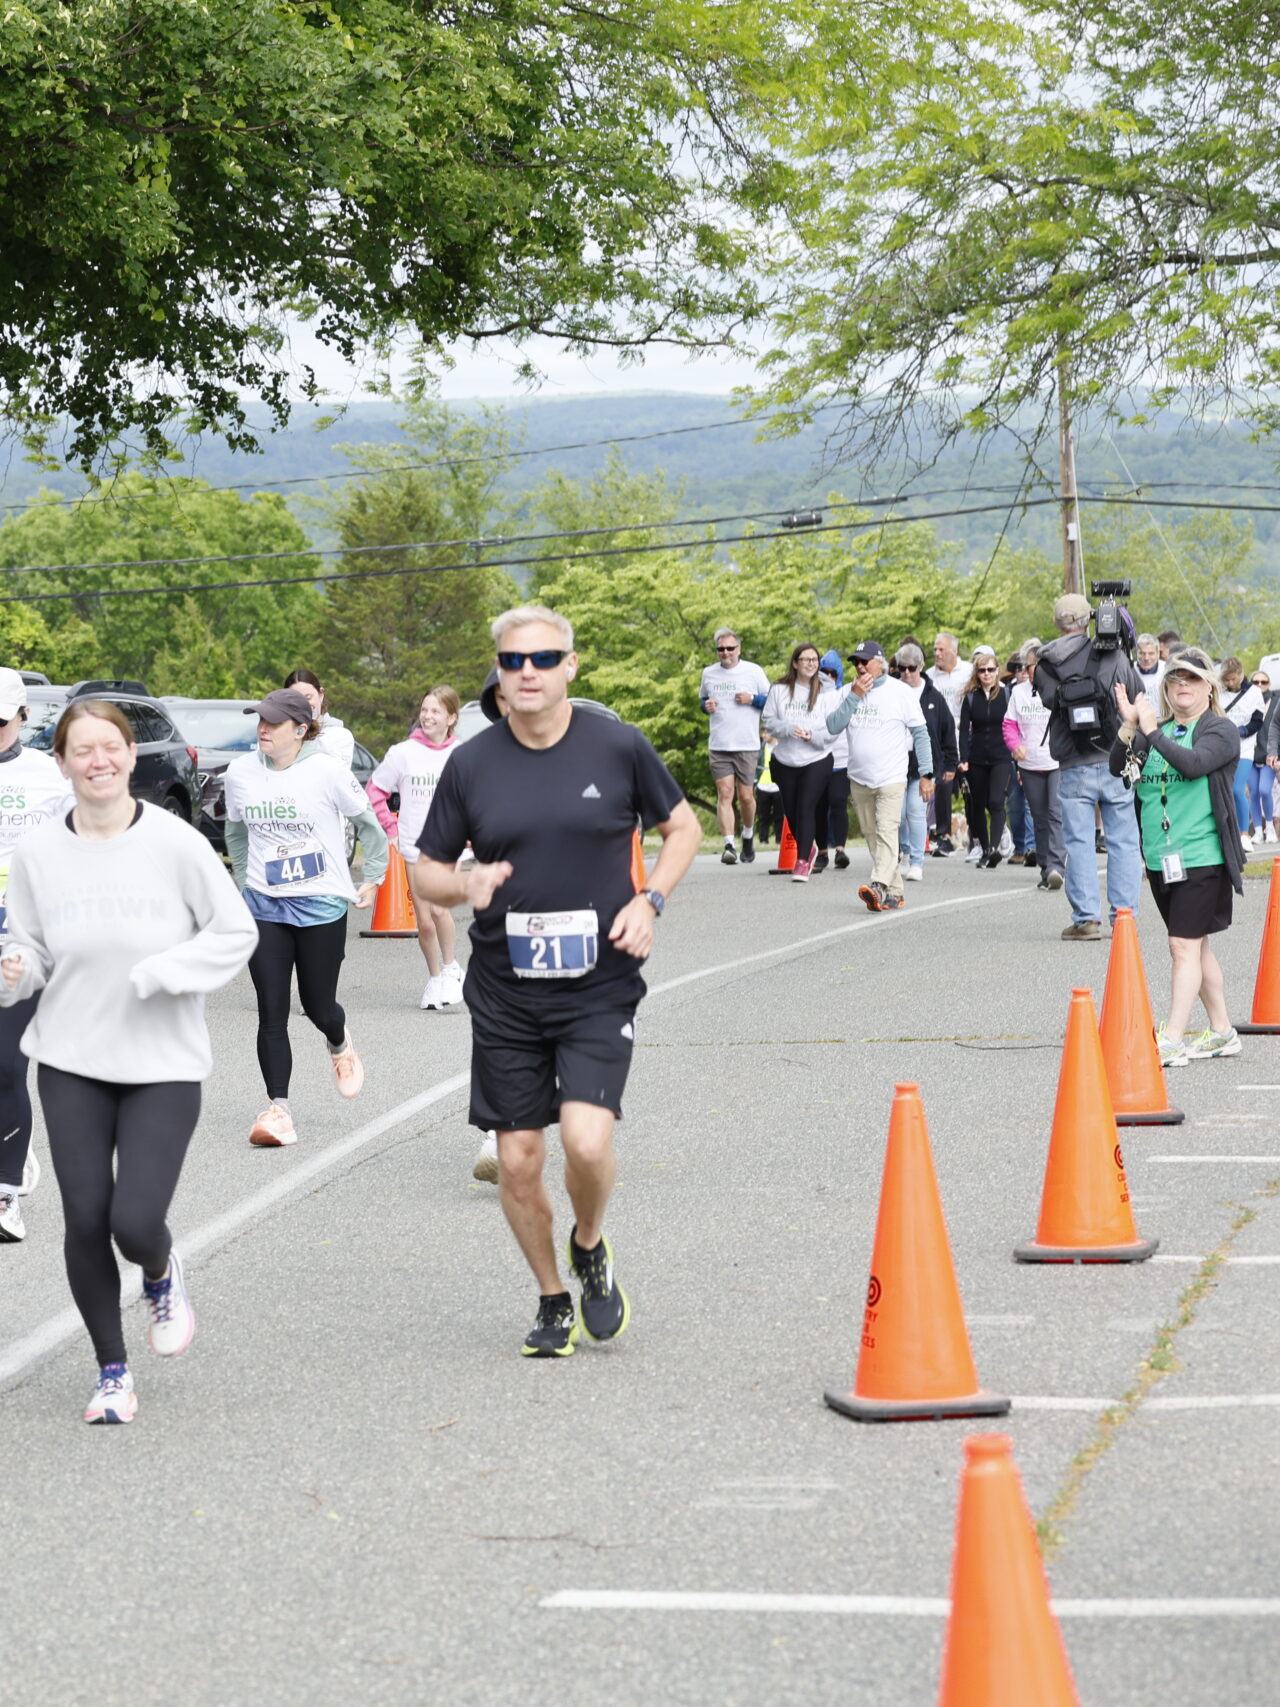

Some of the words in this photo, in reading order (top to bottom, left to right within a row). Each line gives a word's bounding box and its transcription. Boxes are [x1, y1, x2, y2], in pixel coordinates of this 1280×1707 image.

[713, 681, 737, 691] miles
[244, 801, 297, 819] miles
[248, 820, 315, 833] matheny
[281, 857, 306, 882] 44
[530, 936, 563, 969] 21
